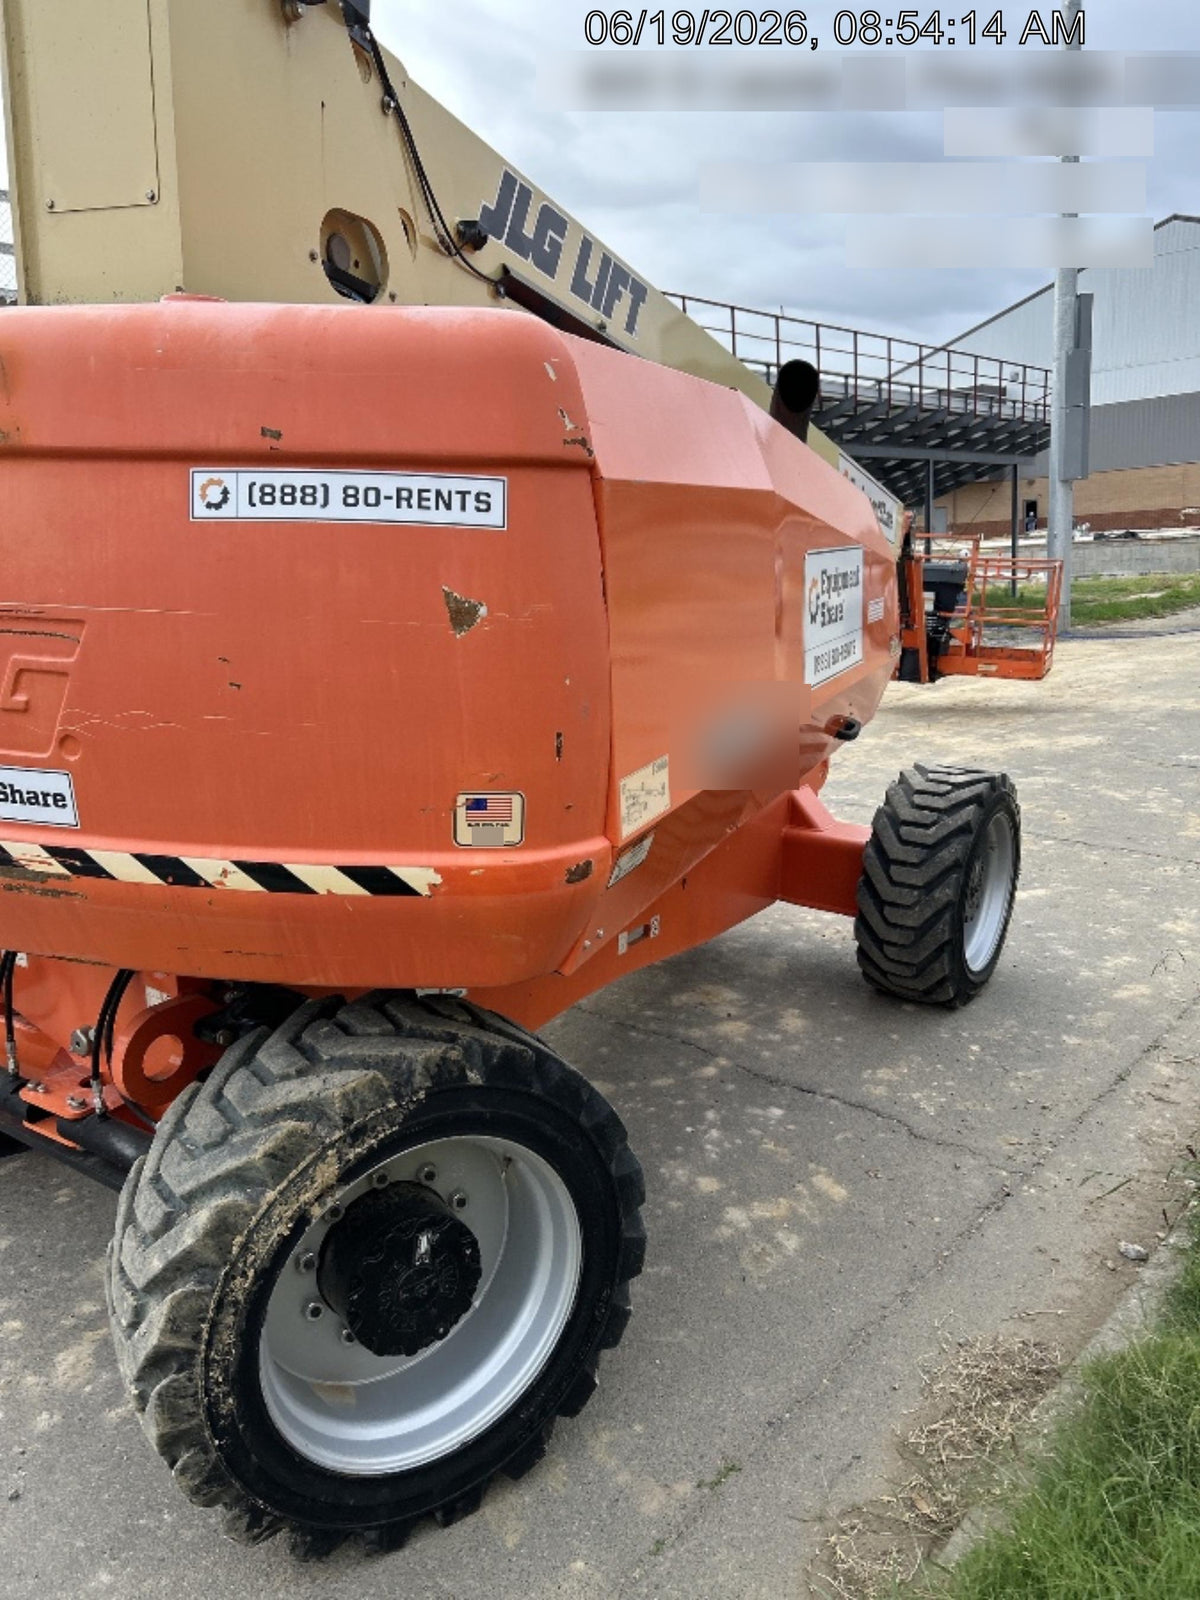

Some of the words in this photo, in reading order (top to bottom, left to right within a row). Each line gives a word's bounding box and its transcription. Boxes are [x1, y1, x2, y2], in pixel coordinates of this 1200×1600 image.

[478, 166, 570, 282] JLG
[569, 233, 648, 338] LIFT
[248, 481, 330, 509] (888)
[342, 484, 492, 514] 80-RENTS
[821, 566, 860, 597] Equipment
